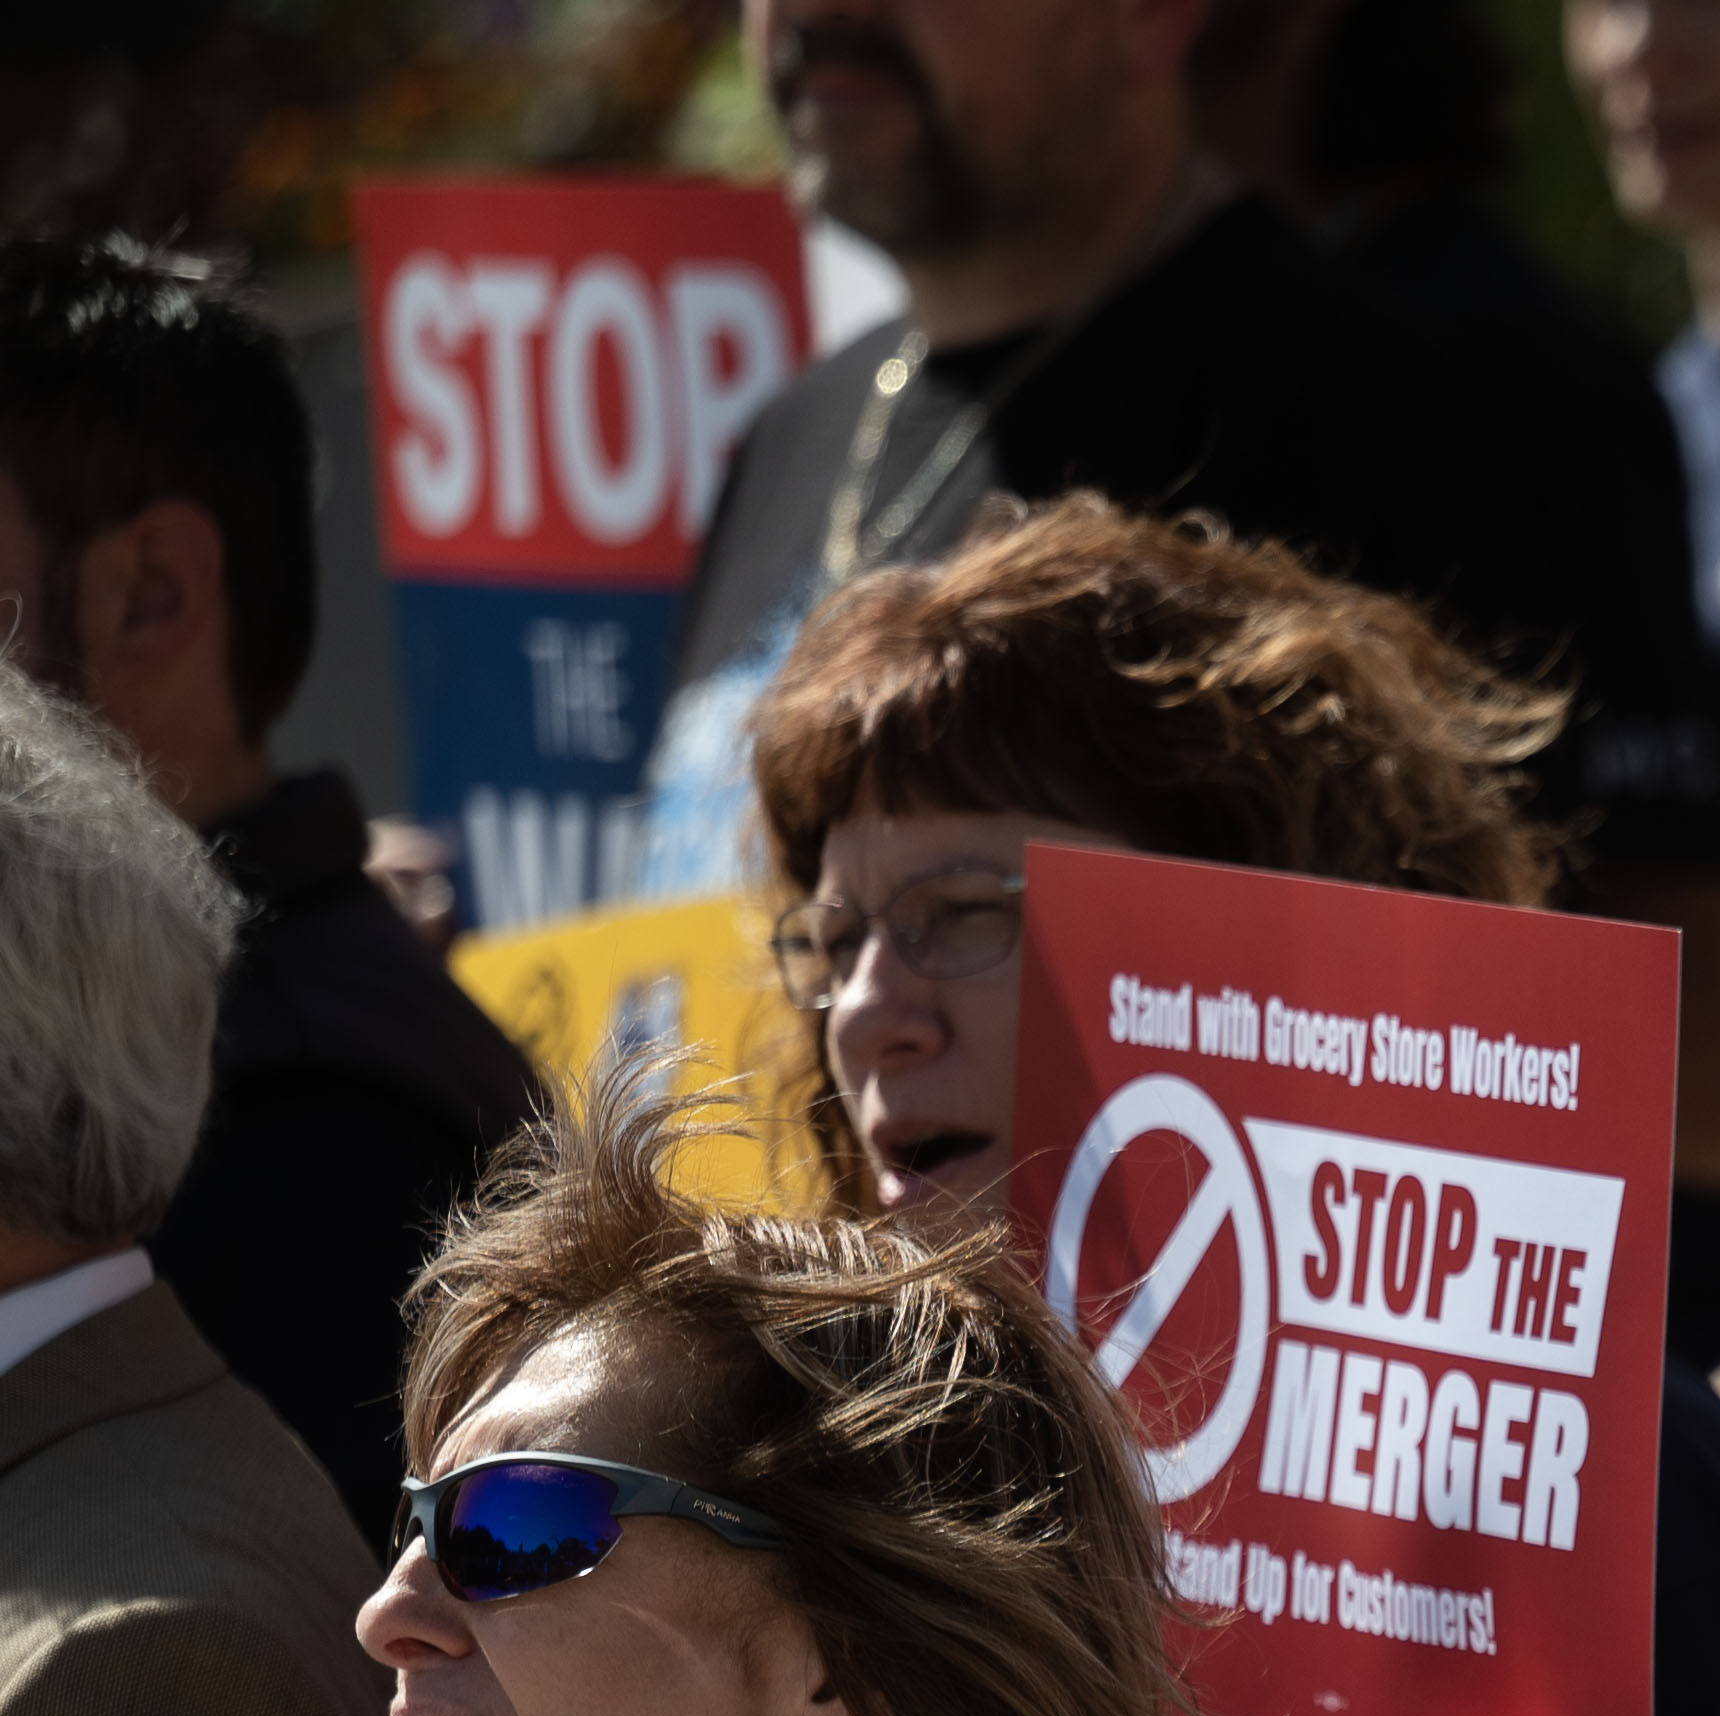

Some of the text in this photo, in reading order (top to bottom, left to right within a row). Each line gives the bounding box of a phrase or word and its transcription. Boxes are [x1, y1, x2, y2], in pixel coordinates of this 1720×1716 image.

[384, 252, 795, 545] STOP
[1108, 972, 1581, 1111] Stand with Grocery Store Workers!
[1303, 1160, 1588, 1346] STOP THE
[1259, 1339, 1591, 1552] MERGER
[1244, 1541, 1288, 1626] Up
[1290, 1549, 1335, 1626] for
[1337, 1558, 1497, 1656] Customers!
